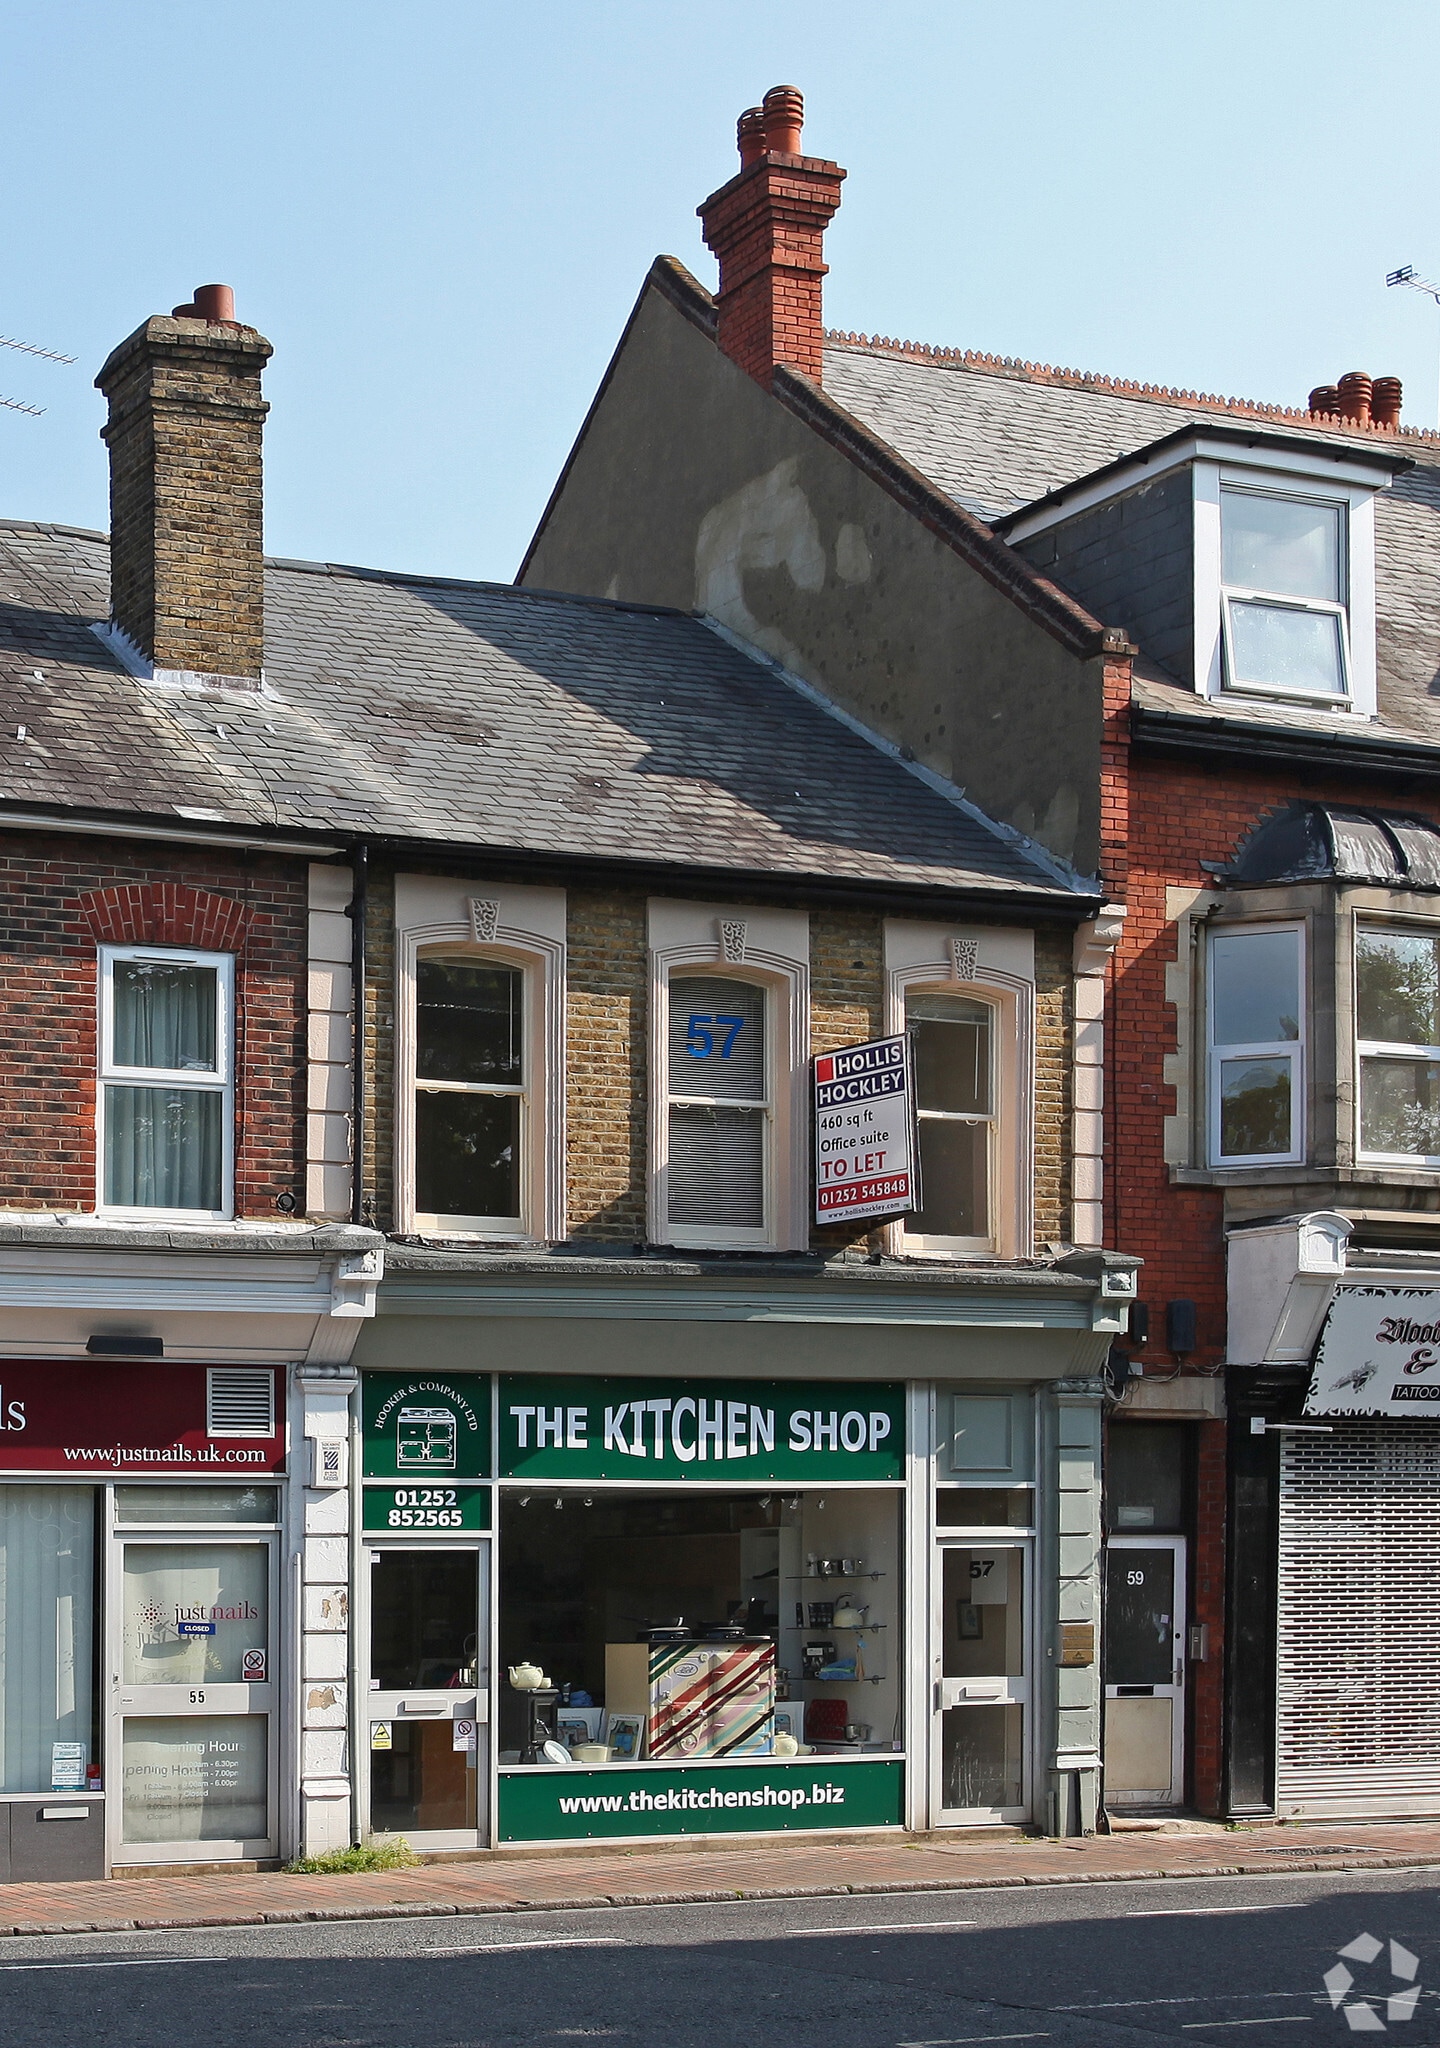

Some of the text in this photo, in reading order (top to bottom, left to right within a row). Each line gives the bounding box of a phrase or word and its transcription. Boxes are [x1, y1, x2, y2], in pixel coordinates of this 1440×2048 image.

[686, 1015, 745, 1058] 57
[838, 1045, 901, 1075] HOLLIS
[819, 1070, 902, 1104] HOCKLEY
[821, 1109, 873, 1130] 460 sq ft
[821, 1130, 889, 1152] Office suite
[821, 1151, 887, 1179] TO LET
[821, 1179, 906, 1205] 01252 545848
[828, 1202, 900, 1218] www.hollishockley.com
[1403, 1348, 1438, 1375] &
[1396, 1387, 1440, 1398] TATTOO
[374, 1381, 478, 1431] HOOKER & COMPANY LTD
[510, 1396, 891, 1461] THE KITCHEN SHOP
[64, 1443, 266, 1467] www.justnails.uk.com
[394, 1488, 457, 1507] 01252
[388, 1508, 463, 1528] 852565
[969, 1560, 995, 1579] 57
[1127, 1570, 1144, 1586] 59
[171, 1601, 259, 1626] just nails
[184, 1625, 210, 1633] CLOSED
[189, 1690, 205, 1704] 55
[559, 1783, 845, 1813] www.thekitchenshop.biz
